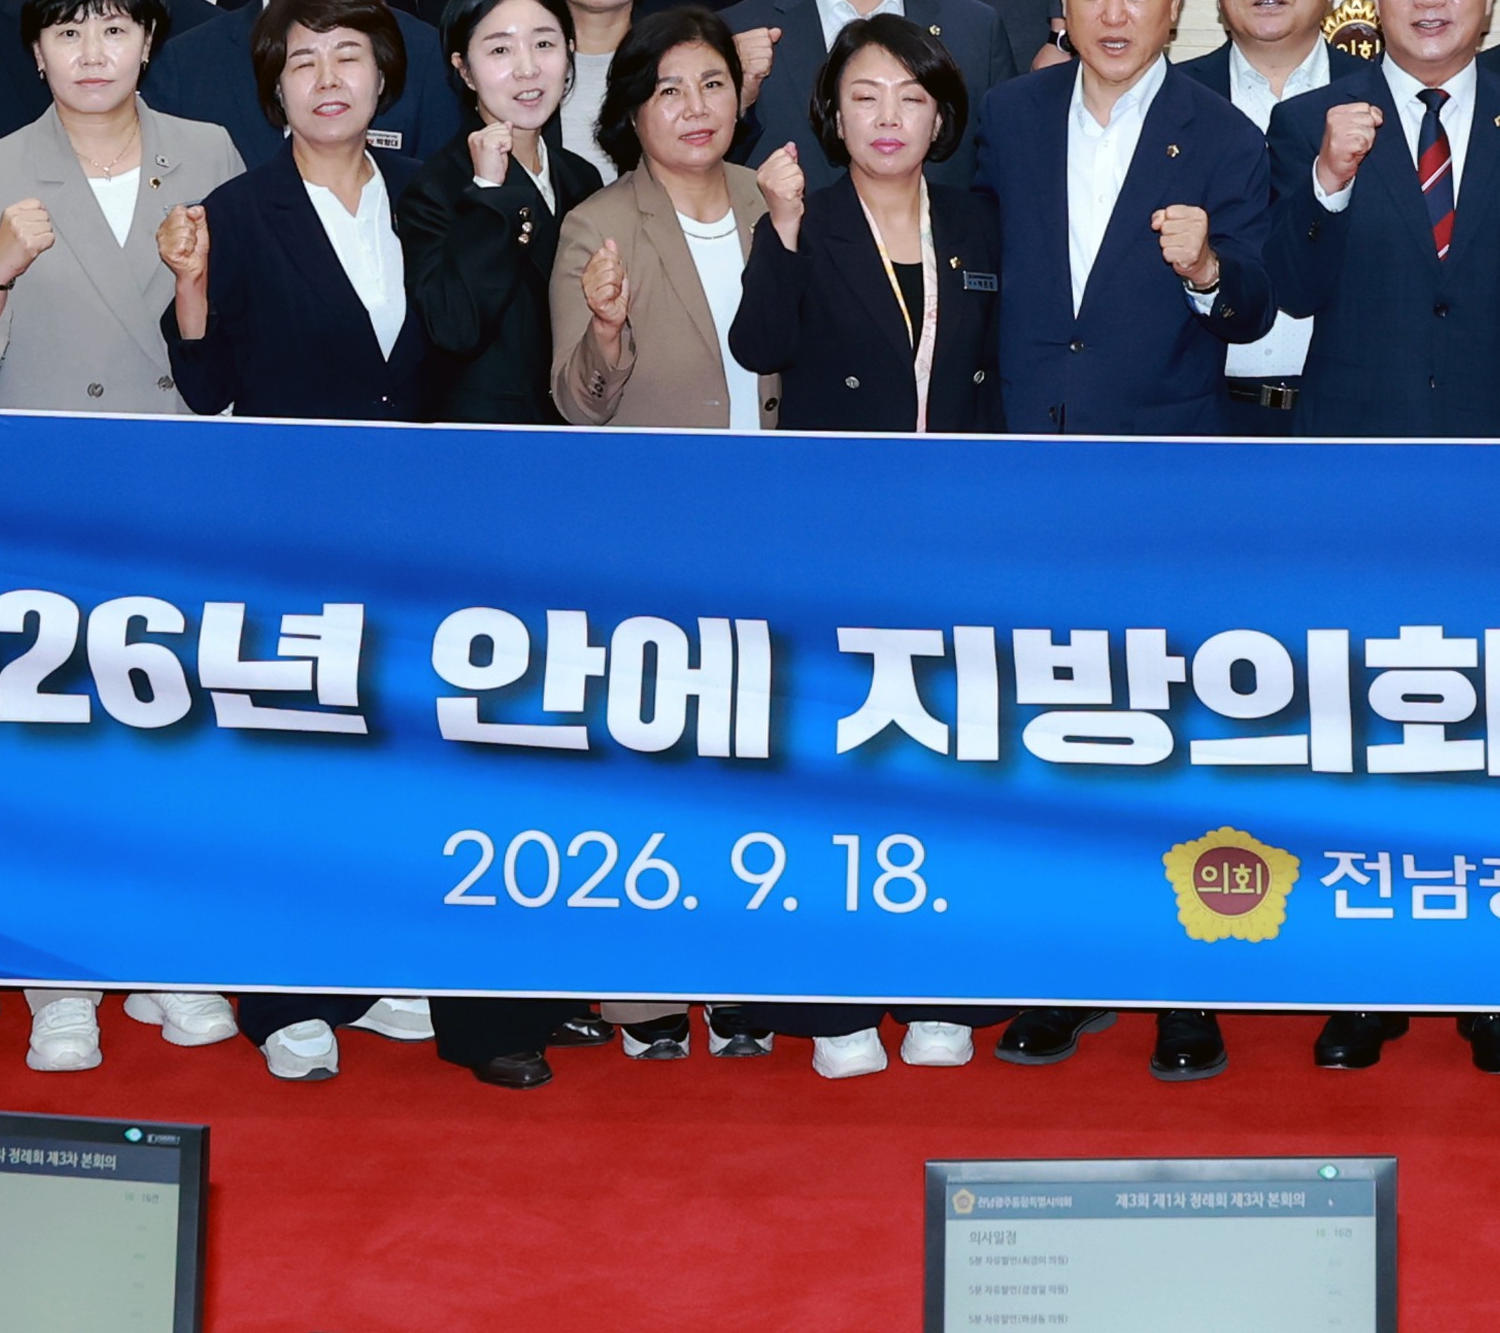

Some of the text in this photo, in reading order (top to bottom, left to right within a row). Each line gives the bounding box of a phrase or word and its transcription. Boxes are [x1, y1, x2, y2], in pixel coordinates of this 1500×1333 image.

[431, 607, 772, 760] 안에
[443, 829, 948, 914] 2026. 9. 18.
[1198, 863, 1265, 898] 의회
[46, 1149, 78, 1168] 제3차
[81, 1153, 116, 1171] 본회의
[1115, 1191, 1149, 1209] 제3회
[1152, 1191, 1186, 1209] 제1차
[1231, 1191, 1264, 1209] 제3차
[1267, 1191, 1306, 1209] 본회의
